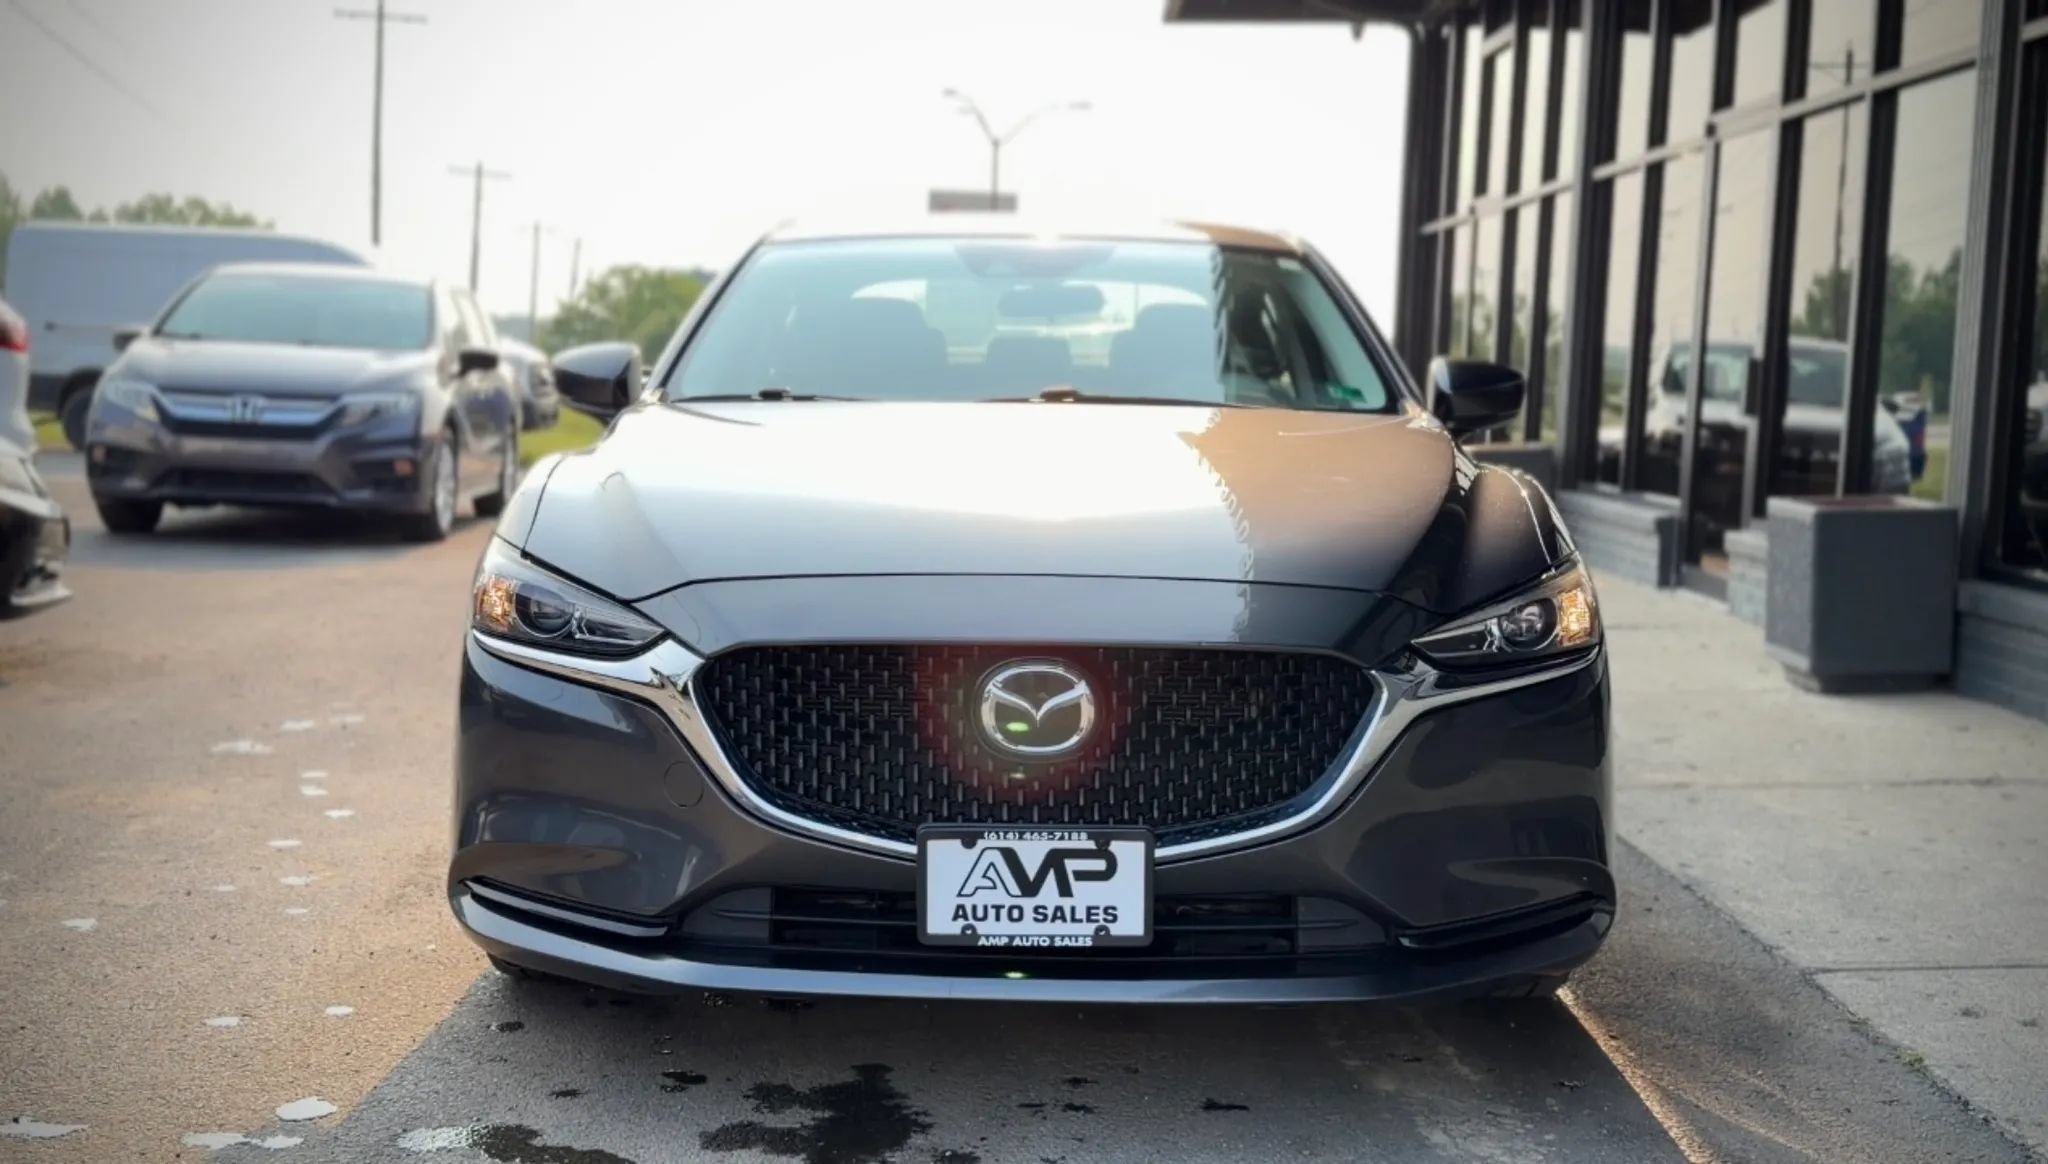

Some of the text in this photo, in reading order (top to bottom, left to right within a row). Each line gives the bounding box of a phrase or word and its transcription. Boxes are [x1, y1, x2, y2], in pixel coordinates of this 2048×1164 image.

[983, 831, 1019, 841] (614)
[956, 847, 1118, 898] AMP
[952, 904, 1118, 924] AUTO SALES
[977, 936, 1093, 947] AMP AUTO SALES
